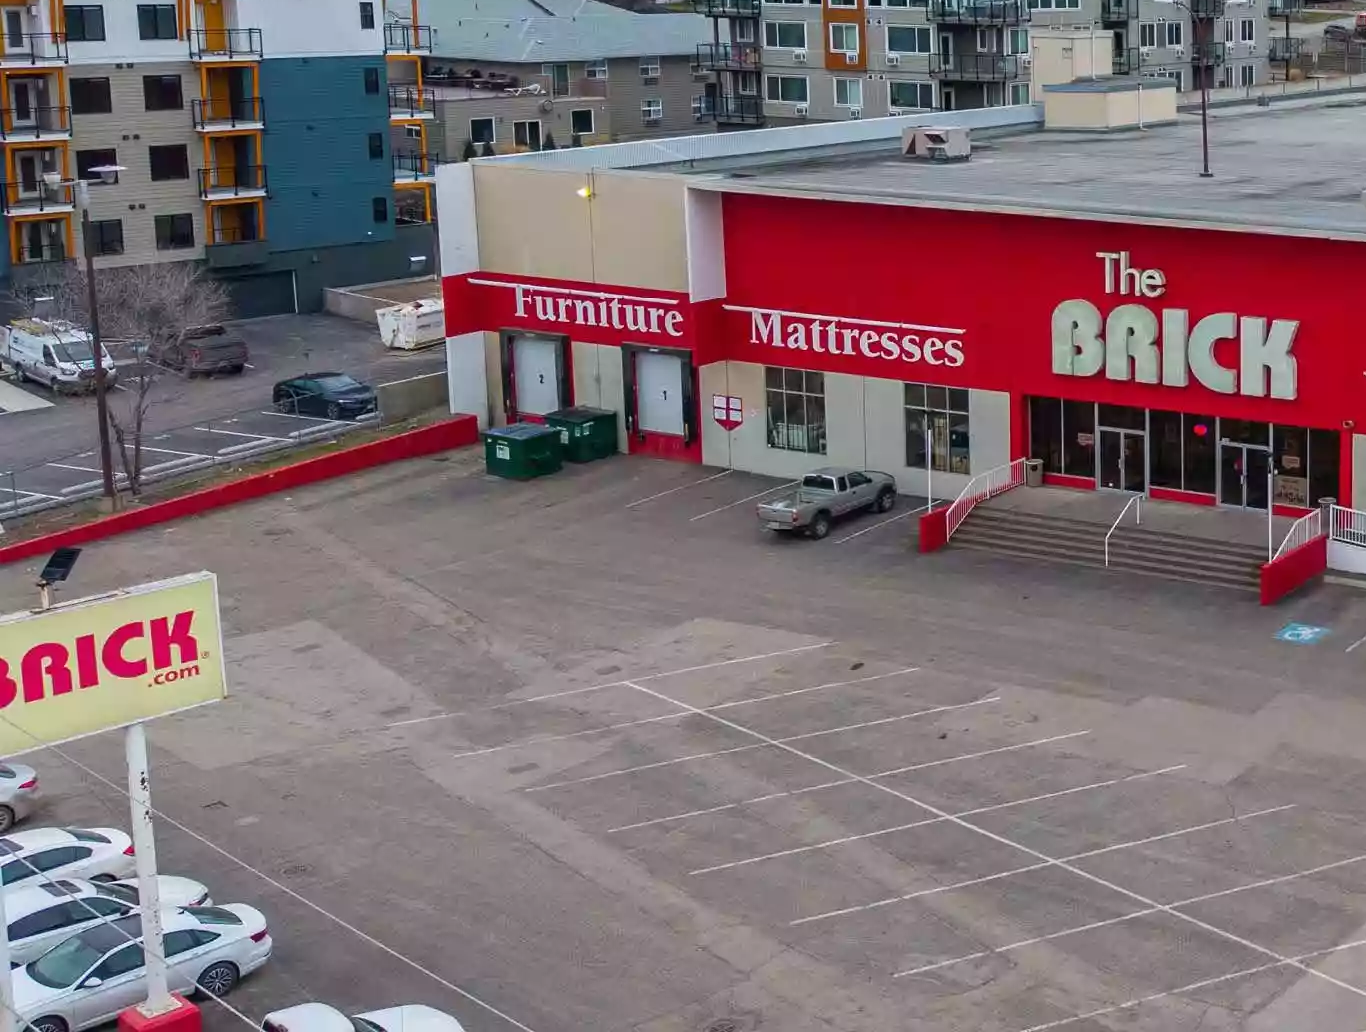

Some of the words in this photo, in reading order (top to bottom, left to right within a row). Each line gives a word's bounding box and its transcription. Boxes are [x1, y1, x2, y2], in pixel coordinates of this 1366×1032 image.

[1096, 251, 1166, 298] The
[514, 284, 684, 337] Furniture
[750, 308, 966, 367] Mattresses
[1051, 299, 1300, 401] BRICK
[538, 374, 545, 384] 2
[147, 664, 200, 688] .com
